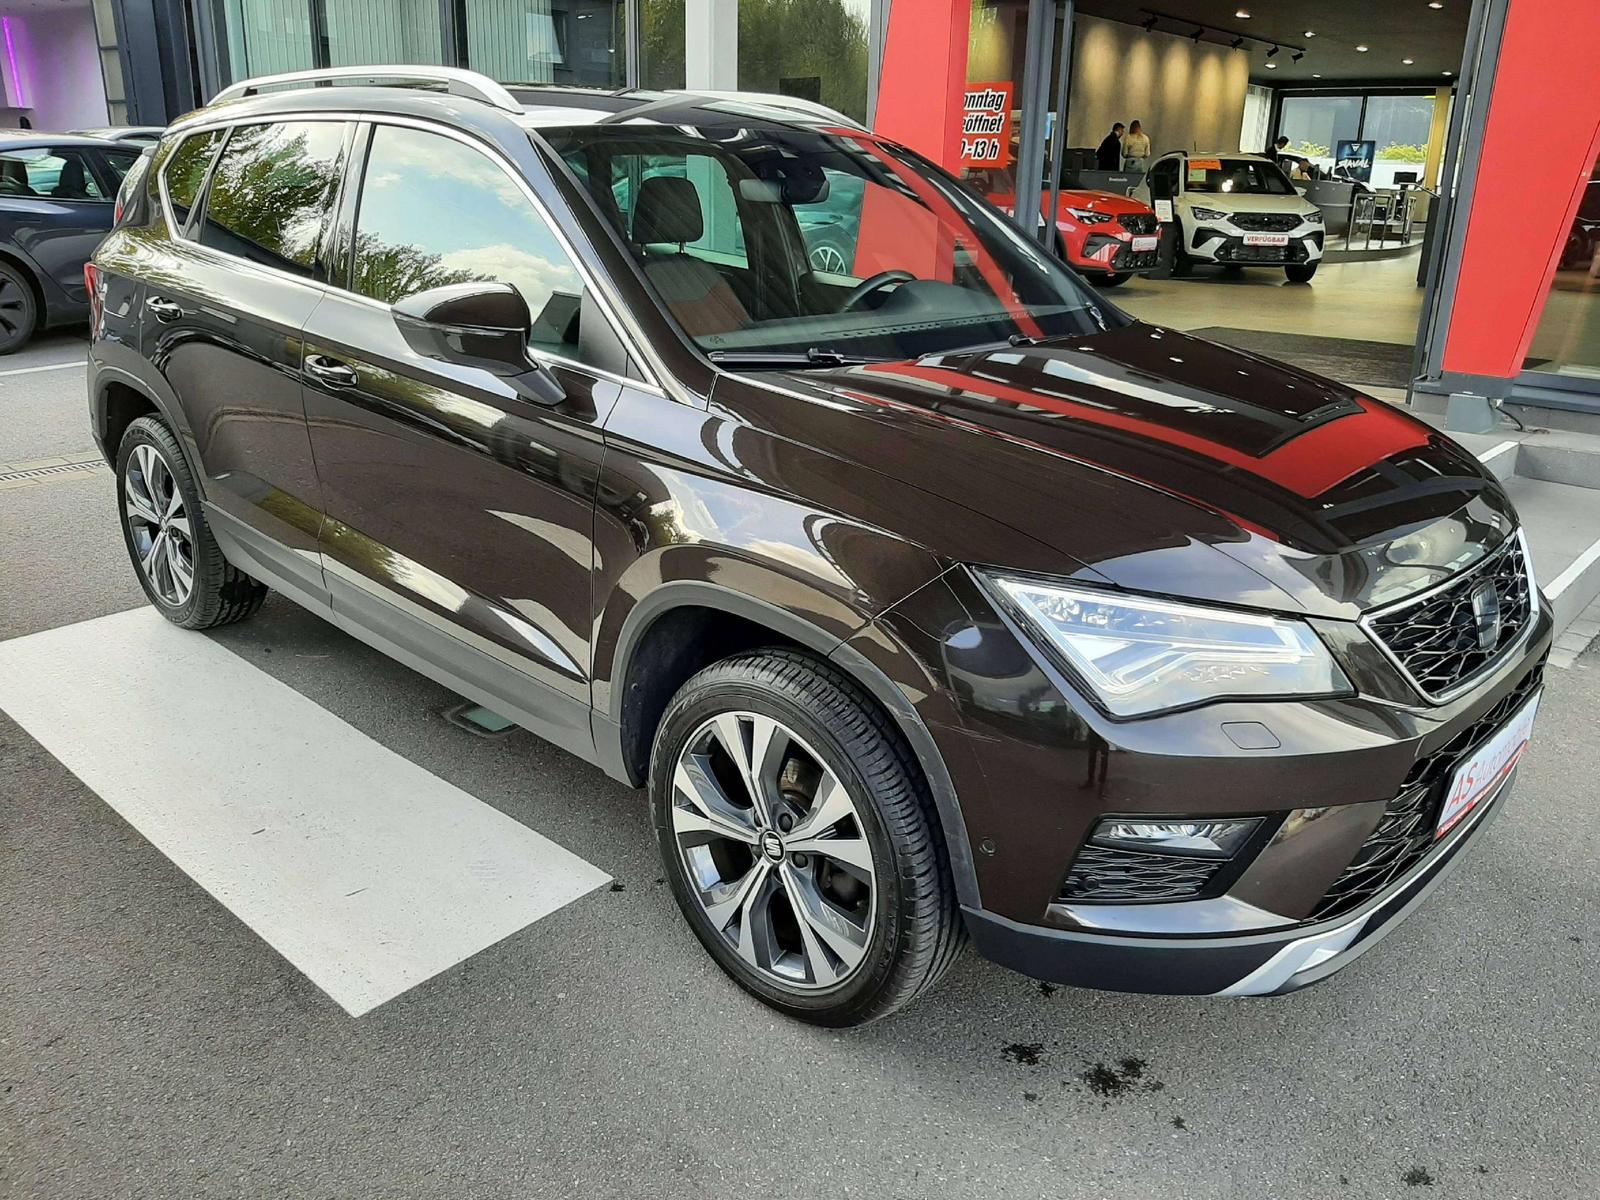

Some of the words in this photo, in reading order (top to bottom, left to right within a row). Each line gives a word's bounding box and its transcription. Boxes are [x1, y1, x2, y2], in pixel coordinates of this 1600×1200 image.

[963, 113, 1004, 133] öffnet
[987, 139, 999, 160] h
[1247, 235, 1286, 243] VERFÜGBAR
